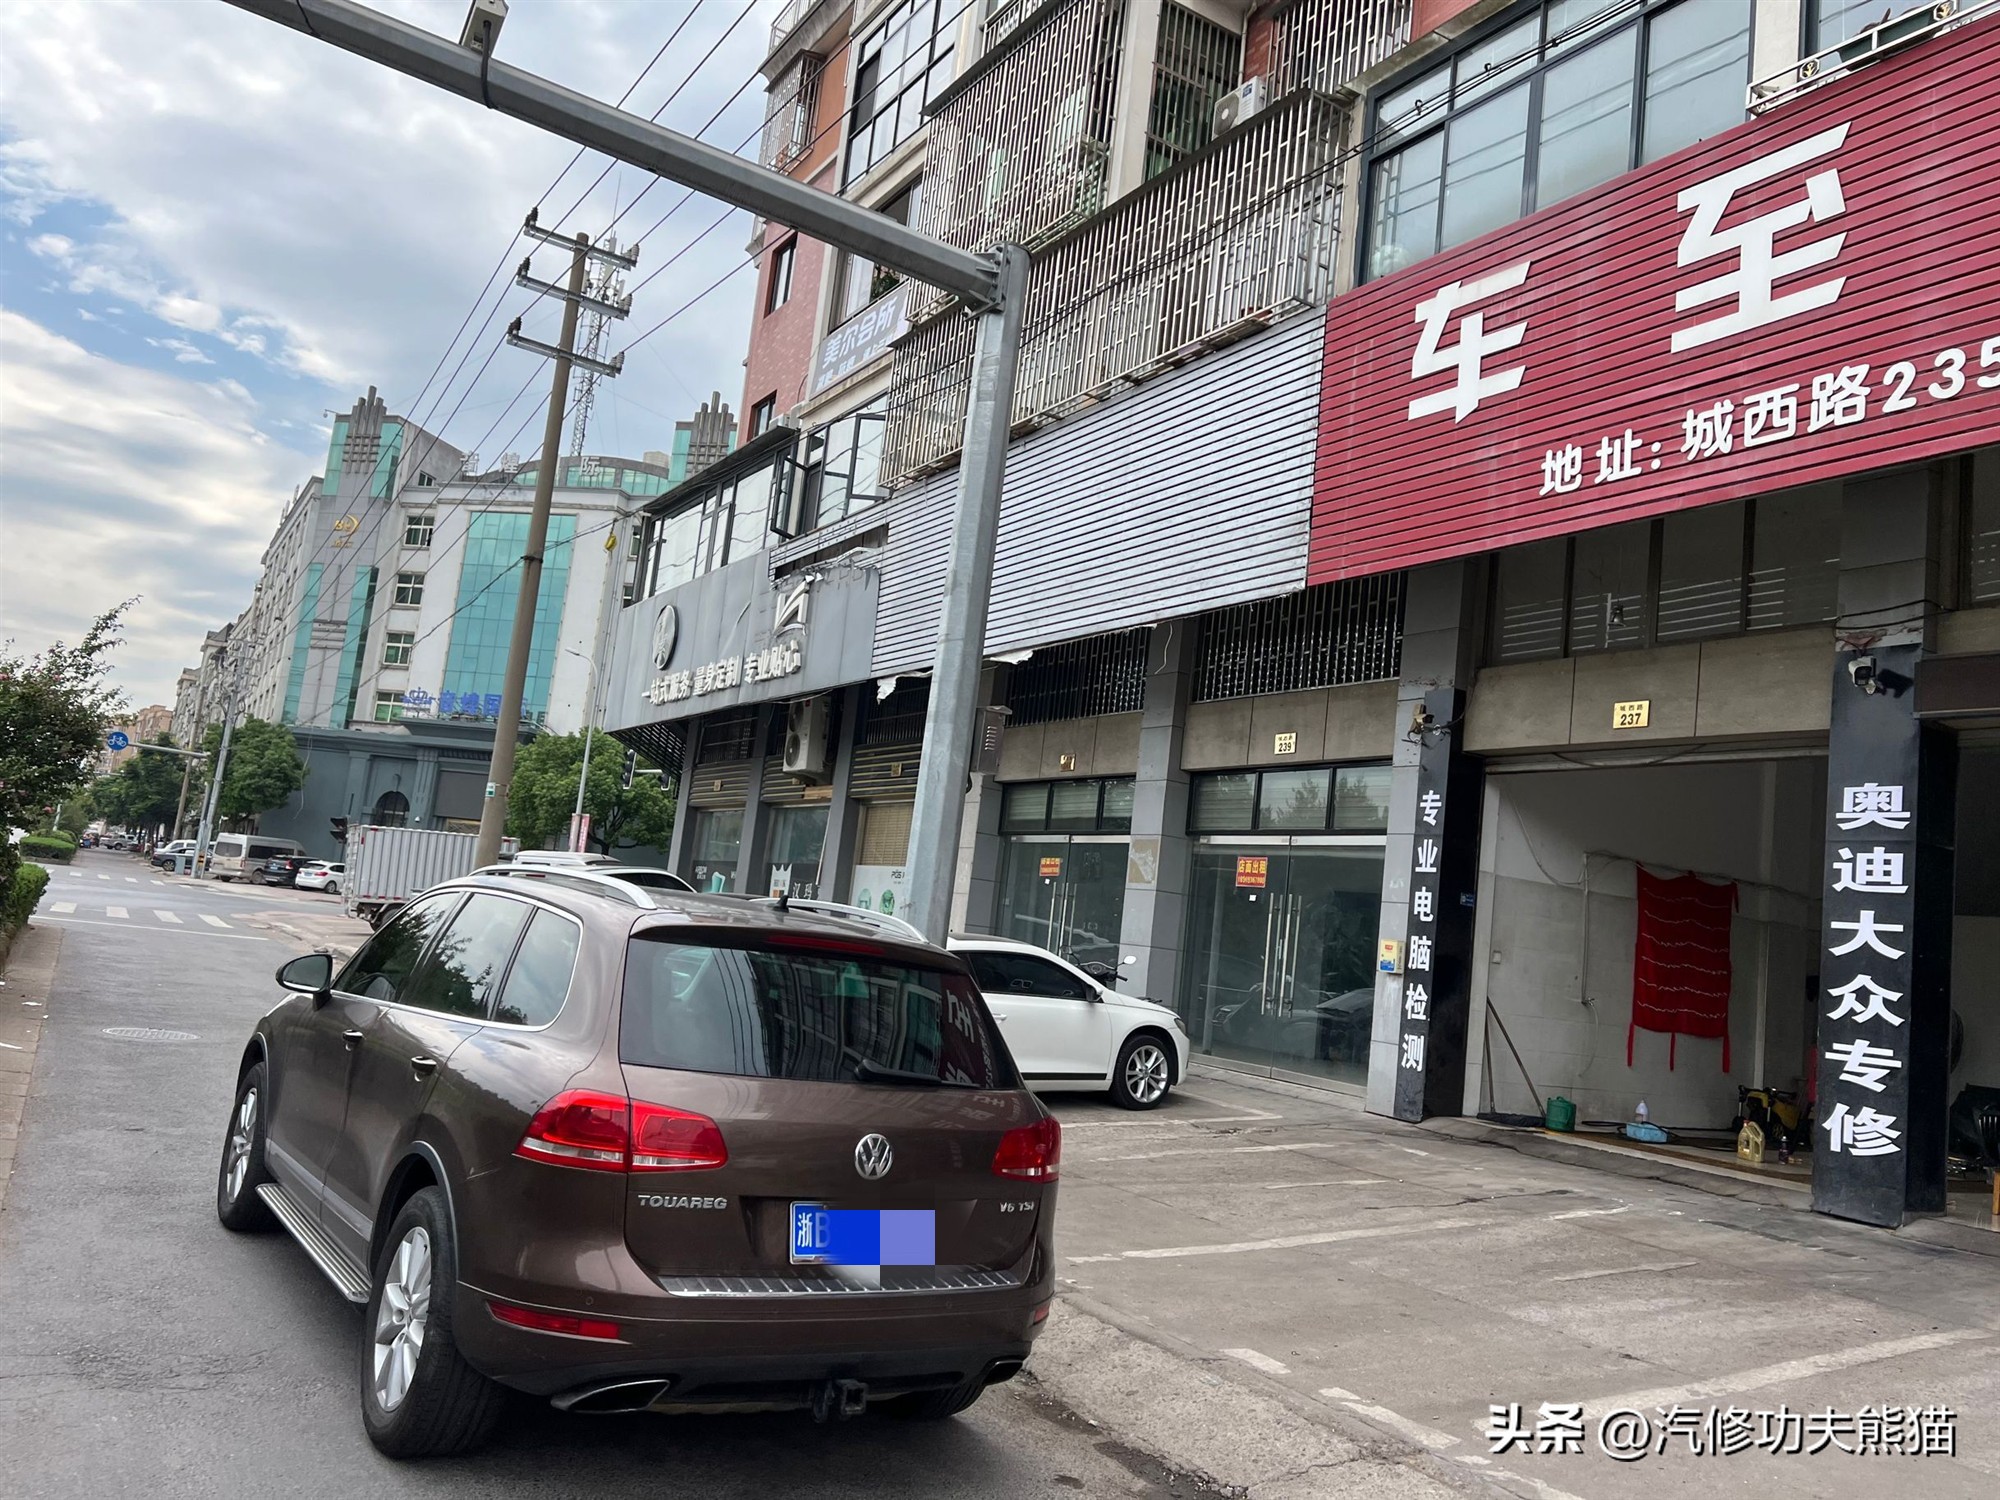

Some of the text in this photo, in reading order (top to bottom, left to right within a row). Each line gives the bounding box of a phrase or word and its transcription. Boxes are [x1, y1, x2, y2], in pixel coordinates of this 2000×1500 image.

[641, 639, 803, 706] 一站式服务 量身定制 专业贴心
[1620, 713, 1641, 726] 237
[1278, 742, 1292, 752] 239
[1401, 789, 1442, 1072] 专业电脑检测
[1822, 782, 1911, 1157] 奥迪大众专修
[638, 1194, 728, 1210] TOUAREG
[1000, 1202, 1015, 1212] V6
